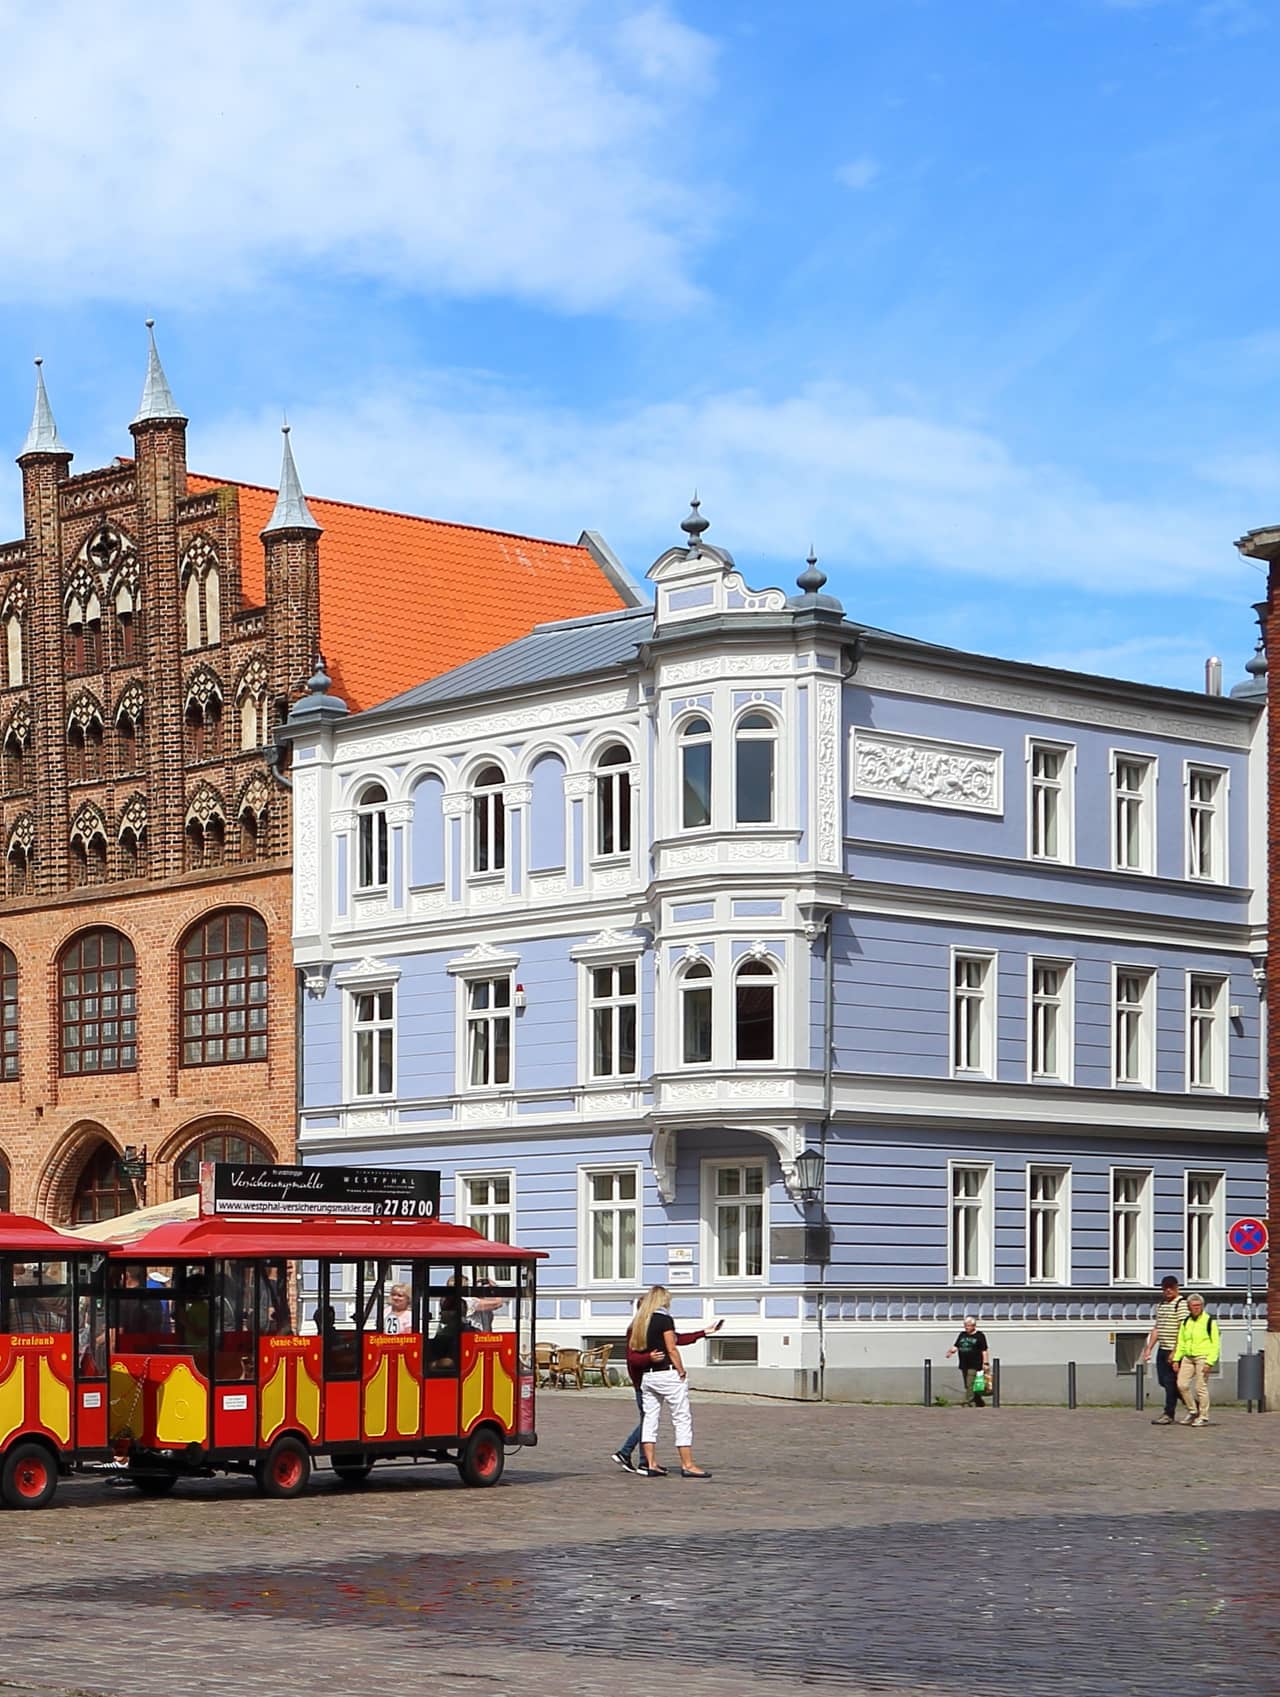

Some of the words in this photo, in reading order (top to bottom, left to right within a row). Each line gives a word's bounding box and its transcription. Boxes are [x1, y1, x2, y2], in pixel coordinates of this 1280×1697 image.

[231, 1170, 324, 1200] Versicherungsmakler
[343, 1176, 415, 1185] WESTPHAL
[218, 1202, 372, 1215] www.westphal-versicherungsmakler.de
[383, 1199, 399, 1215] 27
[401, 1200, 416, 1215] 87
[418, 1200, 433, 1216] 00
[387, 1317, 398, 1334] 25
[10, 1336, 55, 1346] Stralsund
